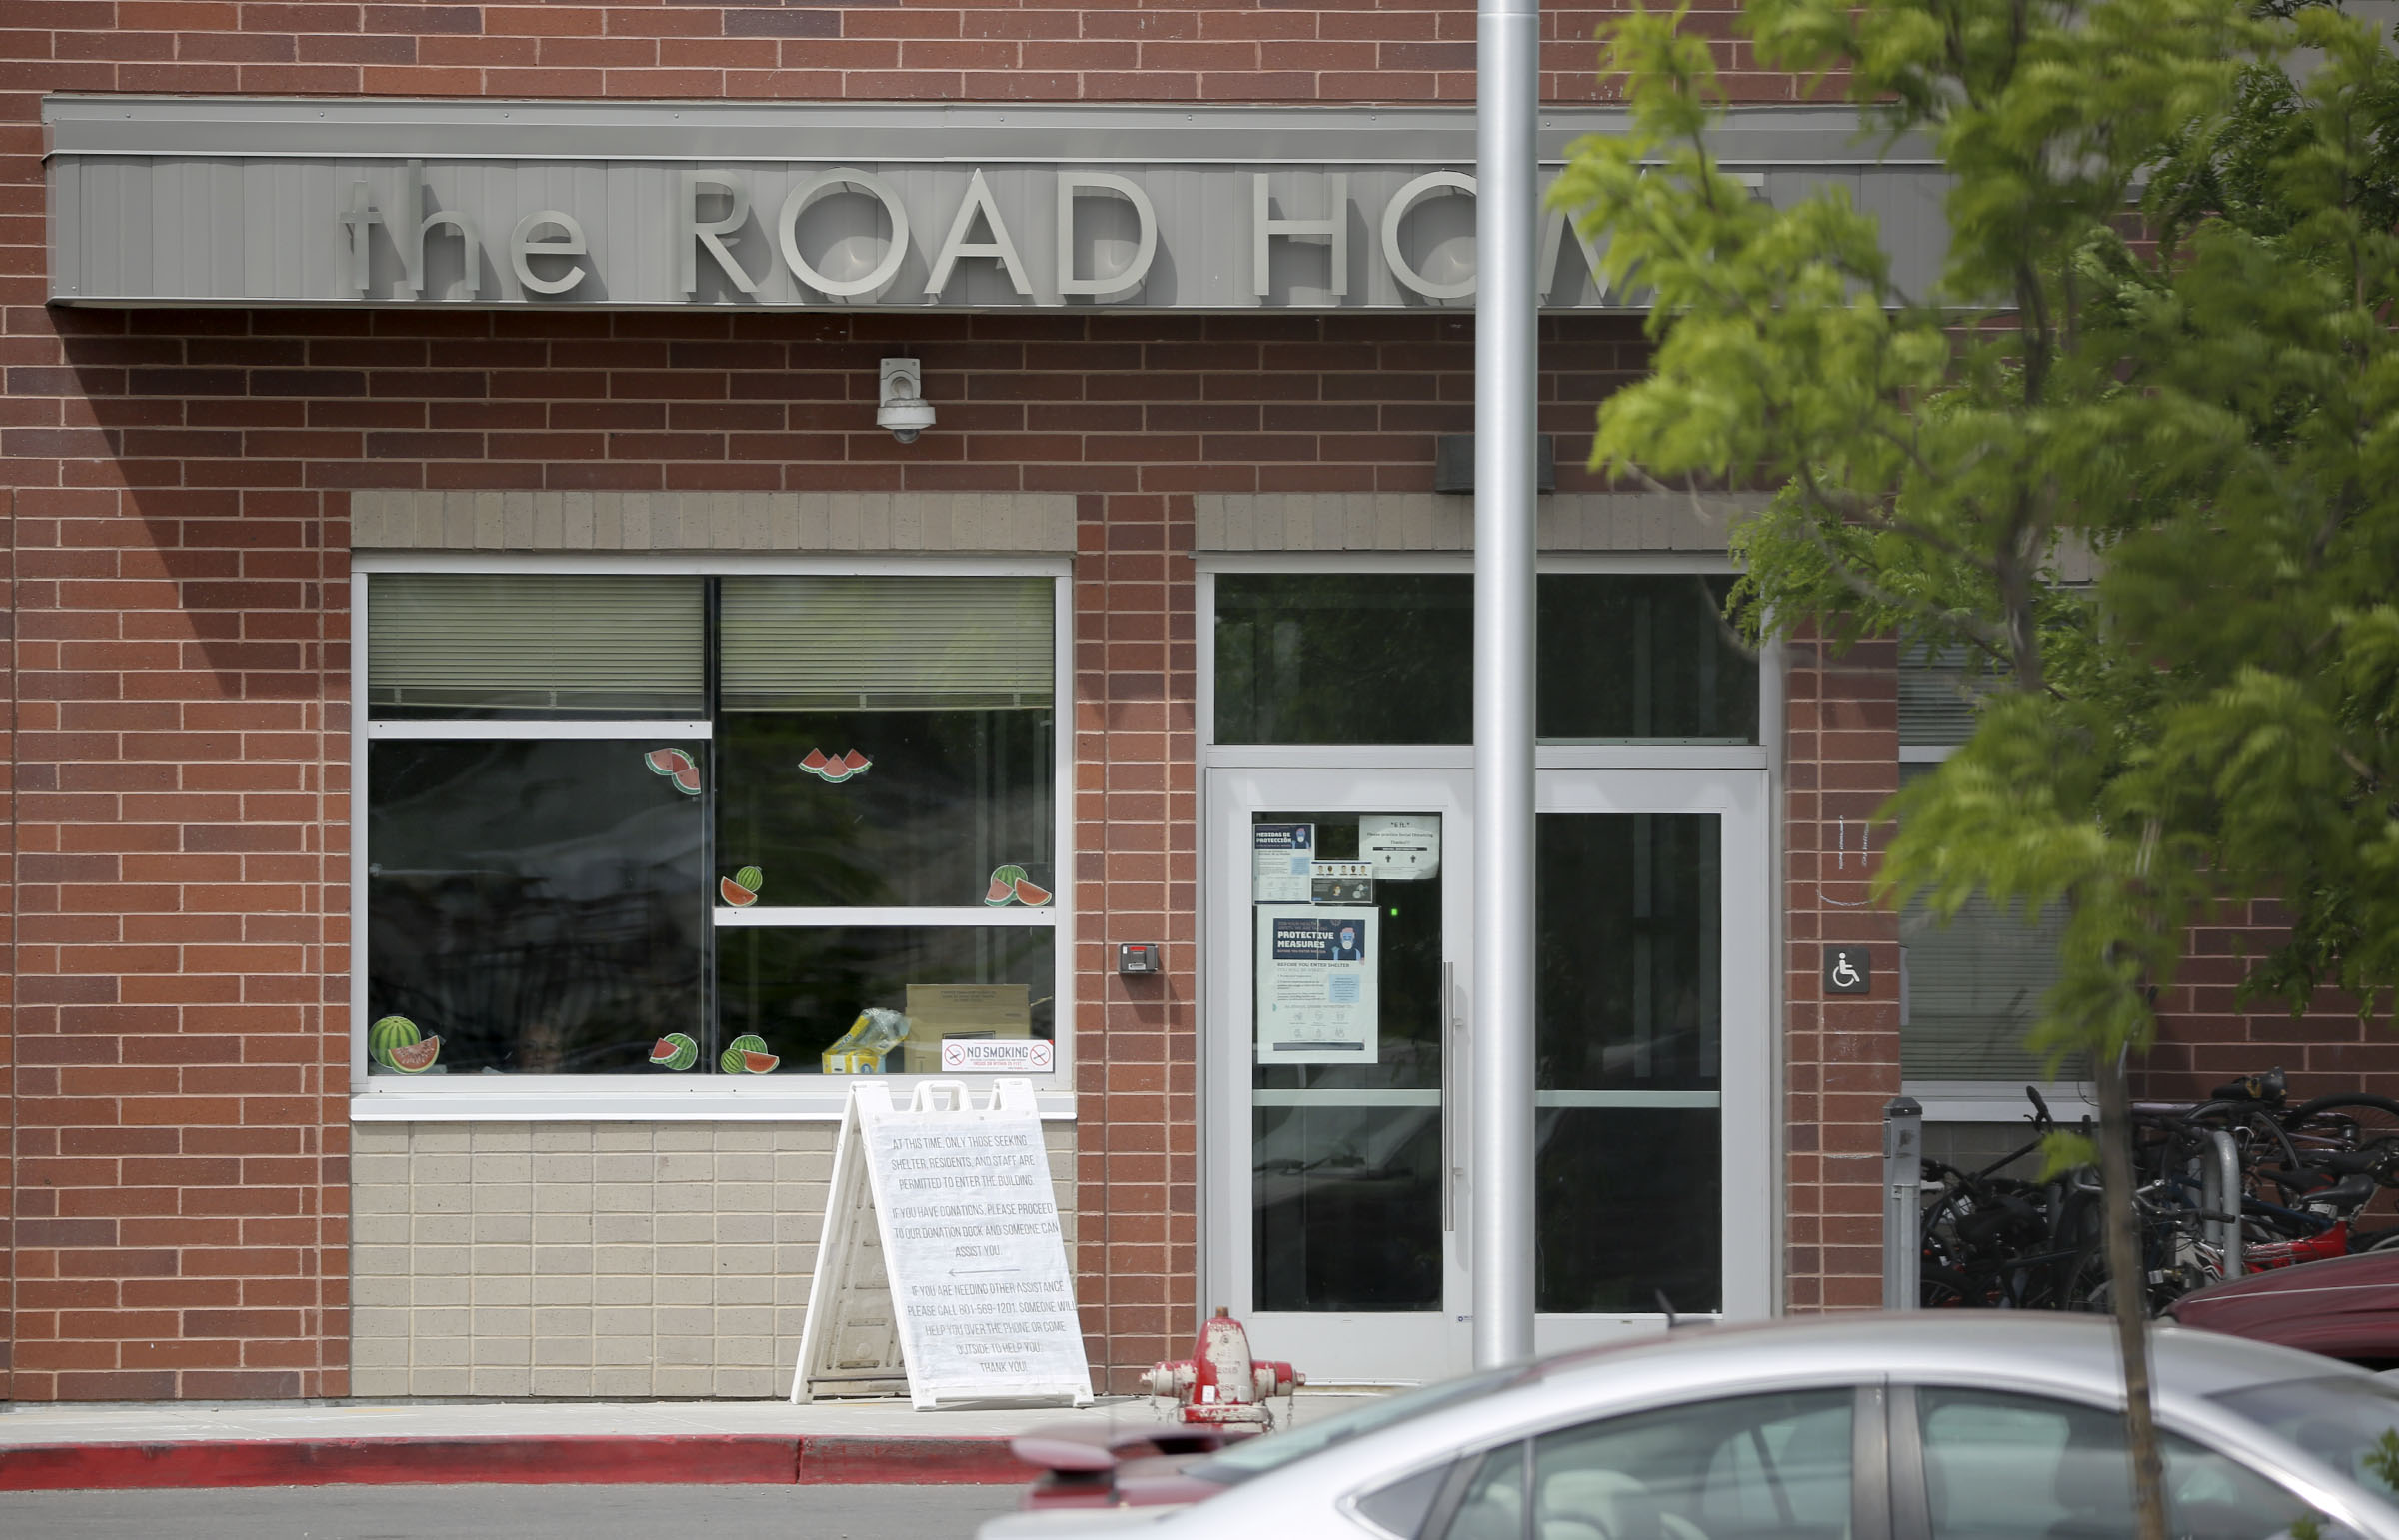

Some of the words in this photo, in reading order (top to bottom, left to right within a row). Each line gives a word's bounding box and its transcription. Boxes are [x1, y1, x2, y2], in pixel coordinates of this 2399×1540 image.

[340, 160, 587, 295] the
[682, 167, 1158, 297] ROAD
[1253, 168, 1765, 299] HOM
[1277, 931, 1335, 940] PROTECTIVE
[967, 1046, 981, 1058] NO
[983, 1046, 1029, 1058] SMOKING
[893, 1138, 902, 1150] AT
[904, 1137, 922, 1149] THIS
[945, 1136, 966, 1148] ONLY
[967, 1135, 994, 1147] THOSE
[994, 1134, 1028, 1147] SEEKING
[975, 1155, 991, 1167] AND
[993, 1155, 1017, 1167] STAFF
[1019, 1154, 1036, 1166] ARE
[899, 1177, 941, 1190] PERMITTED
[942, 1176, 954, 1188] TO
[955, 1175, 980, 1188] ENTER
[981, 1175, 997, 1187] THE
[892, 1207, 900, 1219] IF
[900, 1206, 917, 1218] YOU
[917, 1206, 939, 1218] HAVE
[987, 1203, 1017, 1215] PLEASE
[1017, 1202, 1054, 1214] PROCEED
[893, 1227, 905, 1239] TO
[905, 1227, 921, 1239] OUR
[922, 1226, 961, 1239] DONATION
[985, 1224, 1002, 1236] AND
[1003, 1223, 1041, 1235] SOMEONE
[1041, 1221, 1059, 1234] CAN
[955, 1245, 981, 1257] ASSIST
[912, 1285, 919, 1296] IF
[920, 1285, 936, 1296] YOU
[938, 1284, 953, 1296] ARE
[954, 1283, 989, 1296] NEEDING
[989, 1282, 1016, 1294] OTHER
[1016, 1280, 1065, 1293] ASSISTANCE
[907, 1305, 937, 1317] PLEASE
[938, 1304, 958, 1316] CALL
[1018, 1301, 1056, 1313] SOMEONE
[1057, 1299, 1077, 1312] WILL
[925, 1325, 946, 1336] HELP
[946, 1324, 963, 1336] YOU
[964, 1323, 987, 1335] OVER
[986, 1322, 1003, 1334] THE
[1003, 1321, 1031, 1334] PHONE
[1031, 1321, 1043, 1333] OR
[1043, 1320, 1067, 1332] COME
[956, 1343, 990, 1355] OUTSIDE
[991, 1342, 1002, 1354] TO
[1002, 1342, 1022, 1353] HELP
[979, 1361, 1007, 1373] THANK
